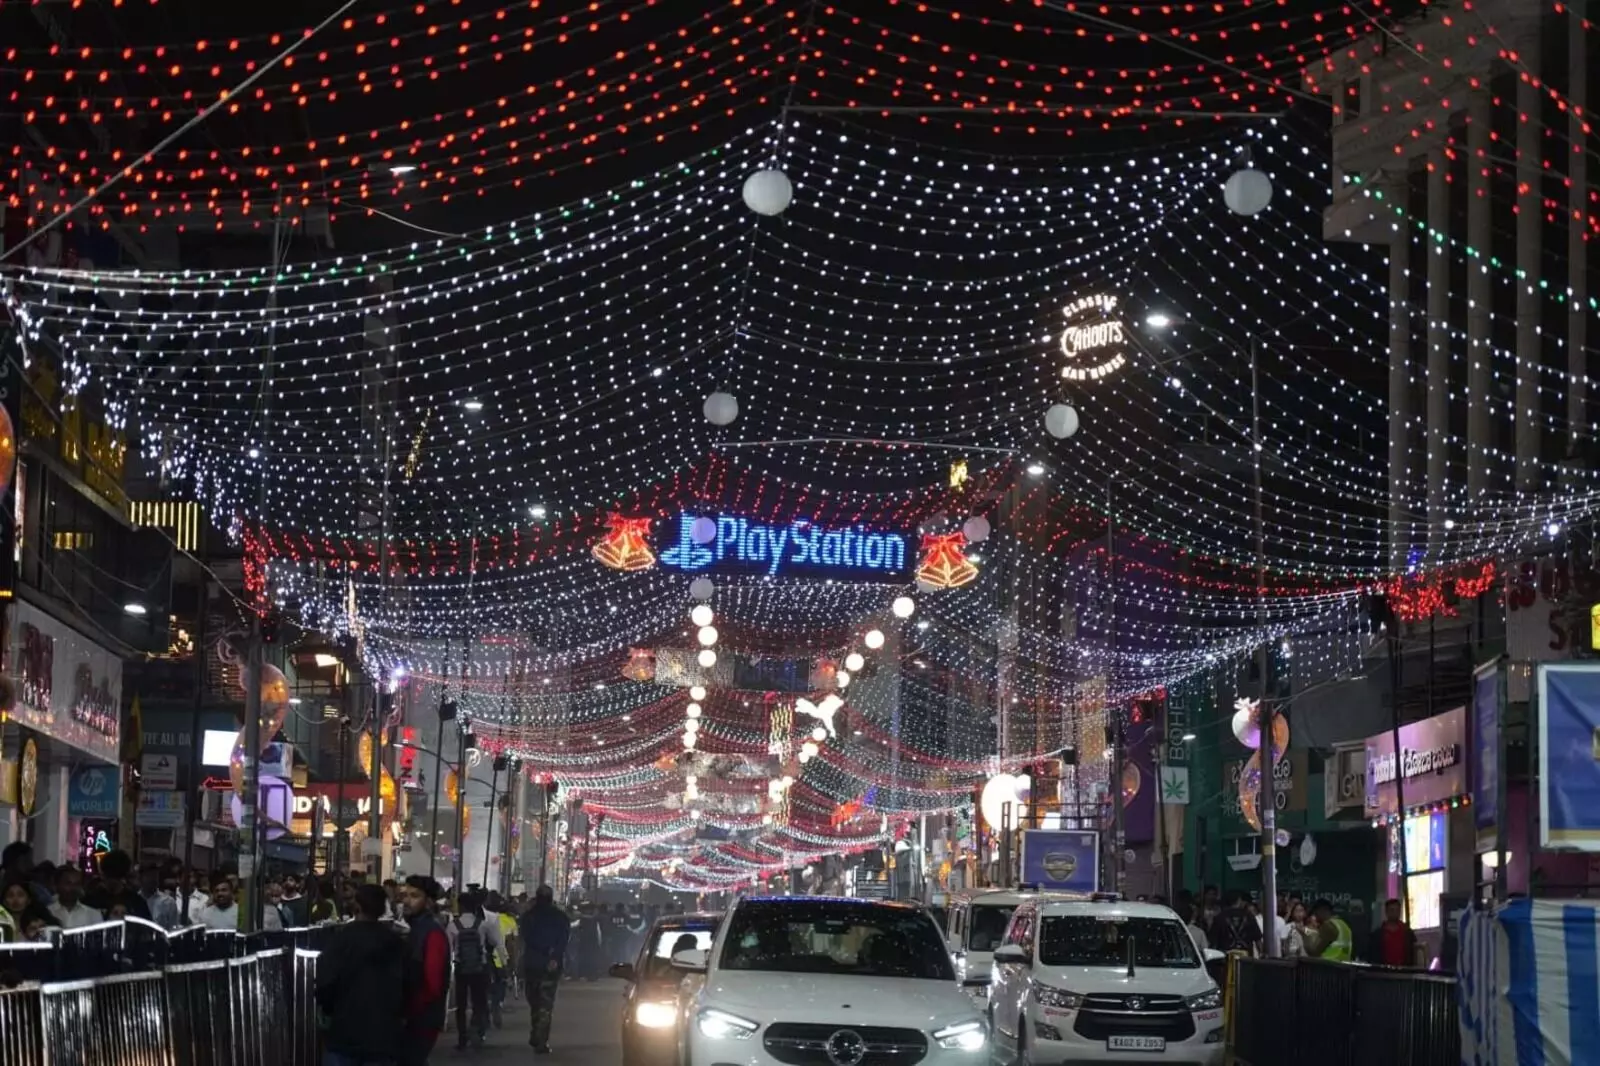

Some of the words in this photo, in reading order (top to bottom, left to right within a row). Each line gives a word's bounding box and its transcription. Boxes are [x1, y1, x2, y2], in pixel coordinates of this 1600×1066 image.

[1060, 321, 1123, 357] CAHOOTS
[717, 515, 905, 575] PlayStation
[71, 800, 114, 812] WORLD
